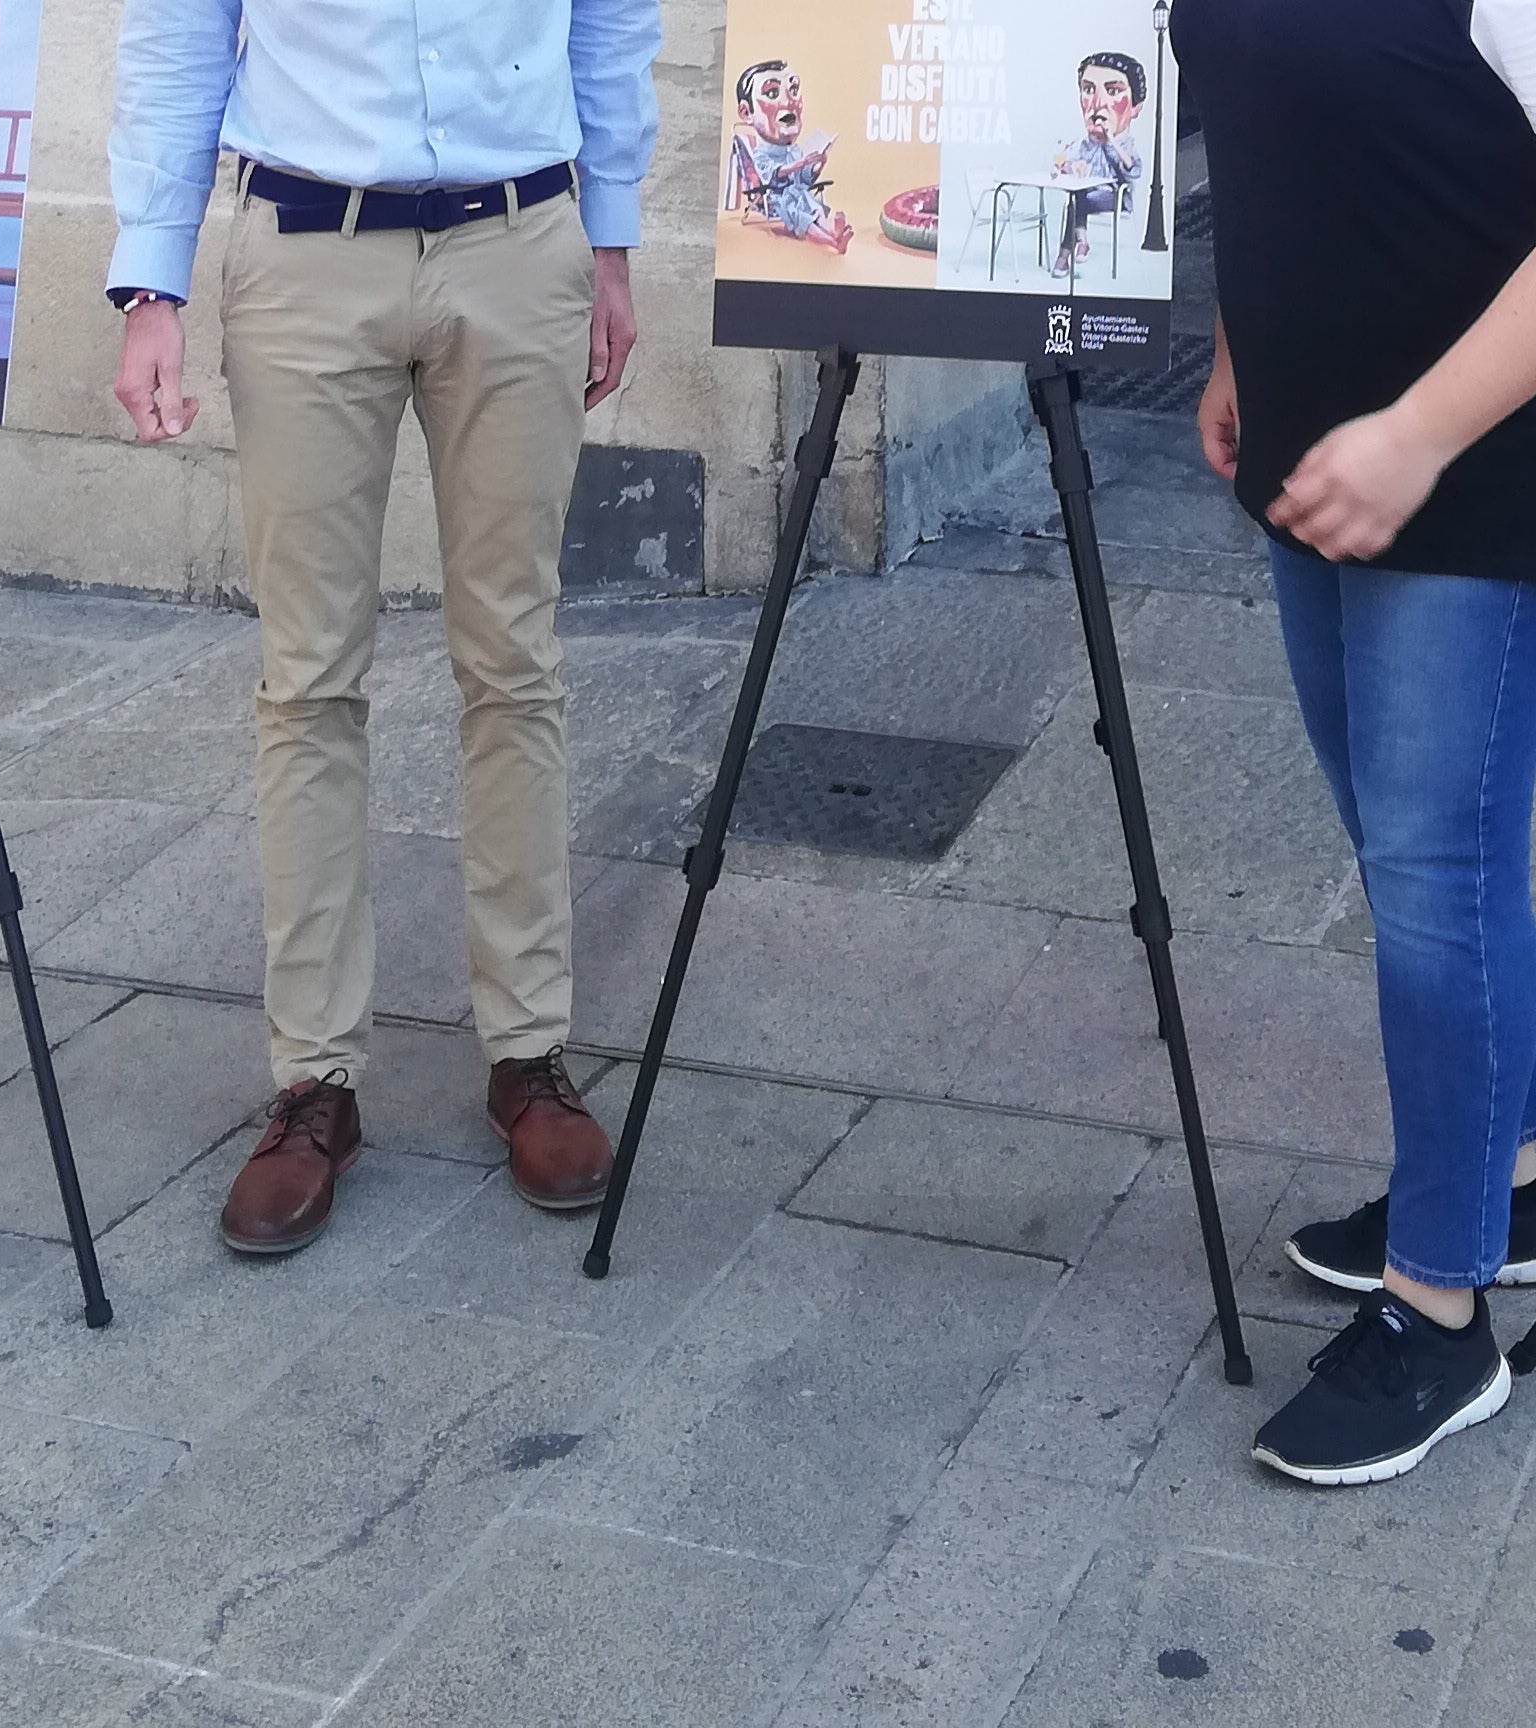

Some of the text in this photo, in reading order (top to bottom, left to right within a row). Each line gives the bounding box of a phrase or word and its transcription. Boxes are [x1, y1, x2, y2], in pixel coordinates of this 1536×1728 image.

[888, 24, 1005, 61] VERANO
[881, 64, 1007, 102] DISFRUTA
[866, 104, 1012, 144] CON CABEZA
